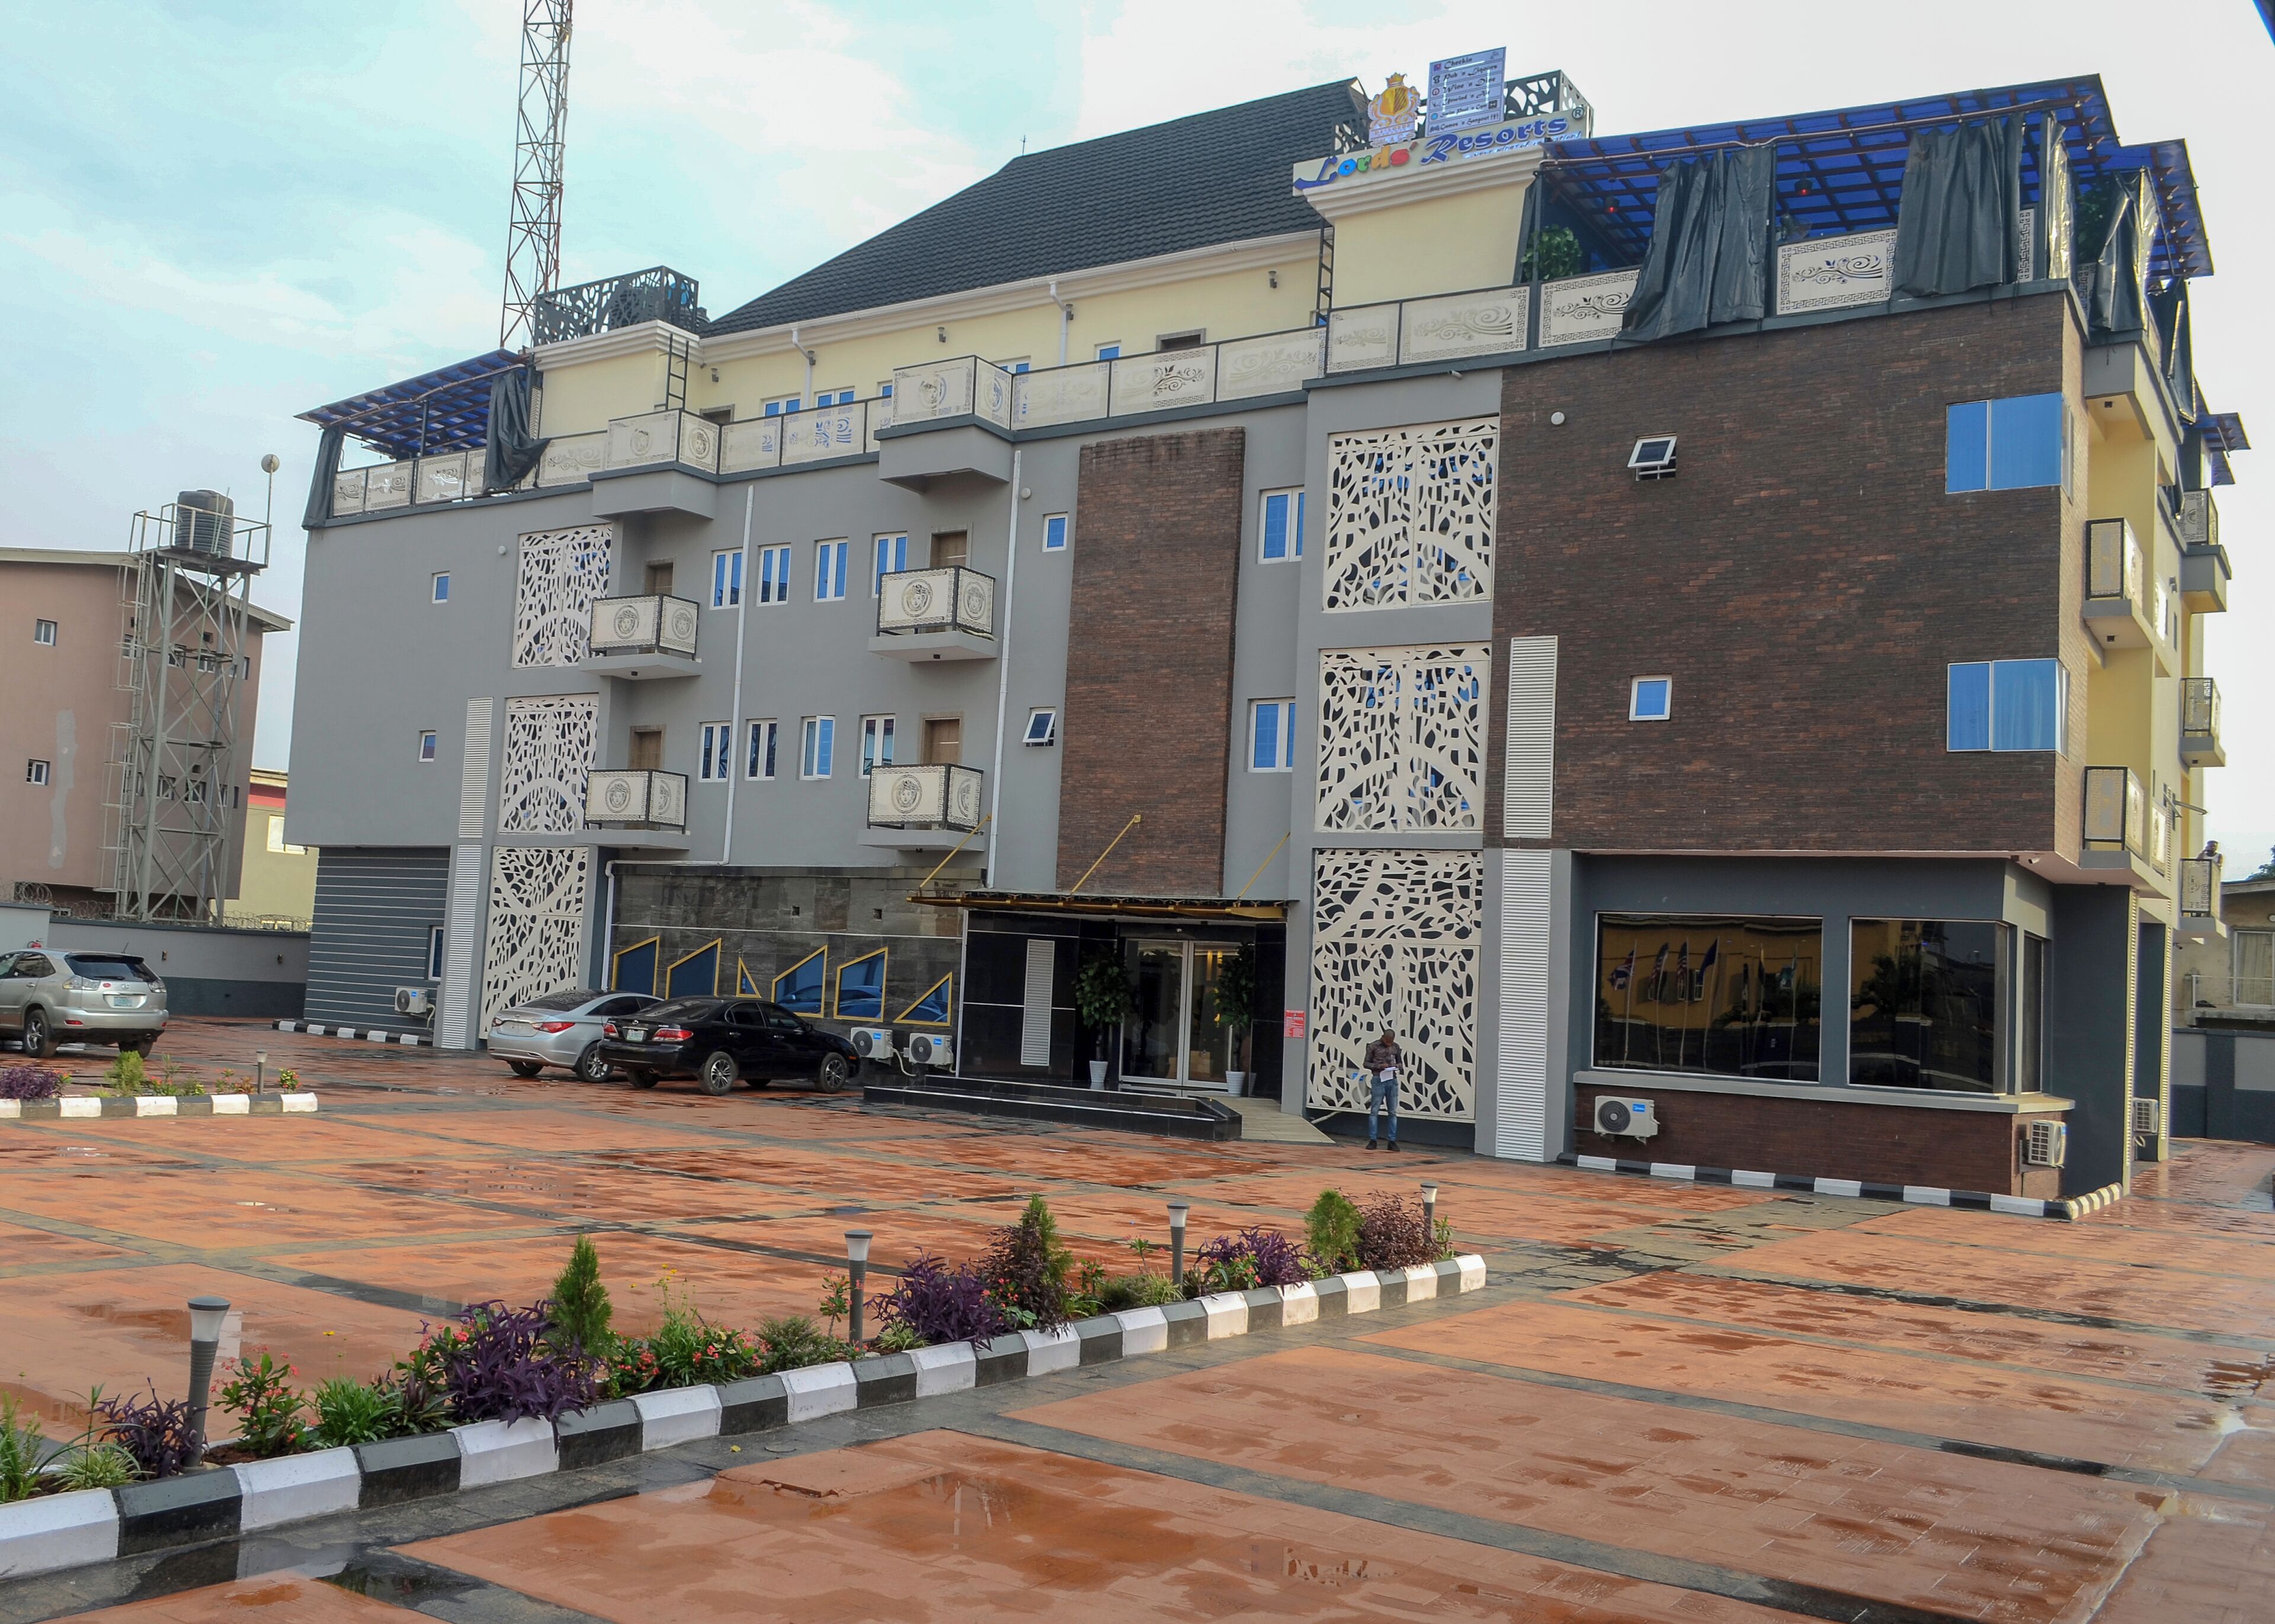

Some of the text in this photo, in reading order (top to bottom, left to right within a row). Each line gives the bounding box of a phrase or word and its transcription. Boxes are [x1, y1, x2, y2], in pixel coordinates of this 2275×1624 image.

[1444, 57, 1473, 69] Checkin
[1294, 142, 1418, 190] Lords'
[1421, 117, 1569, 165] Resorts
